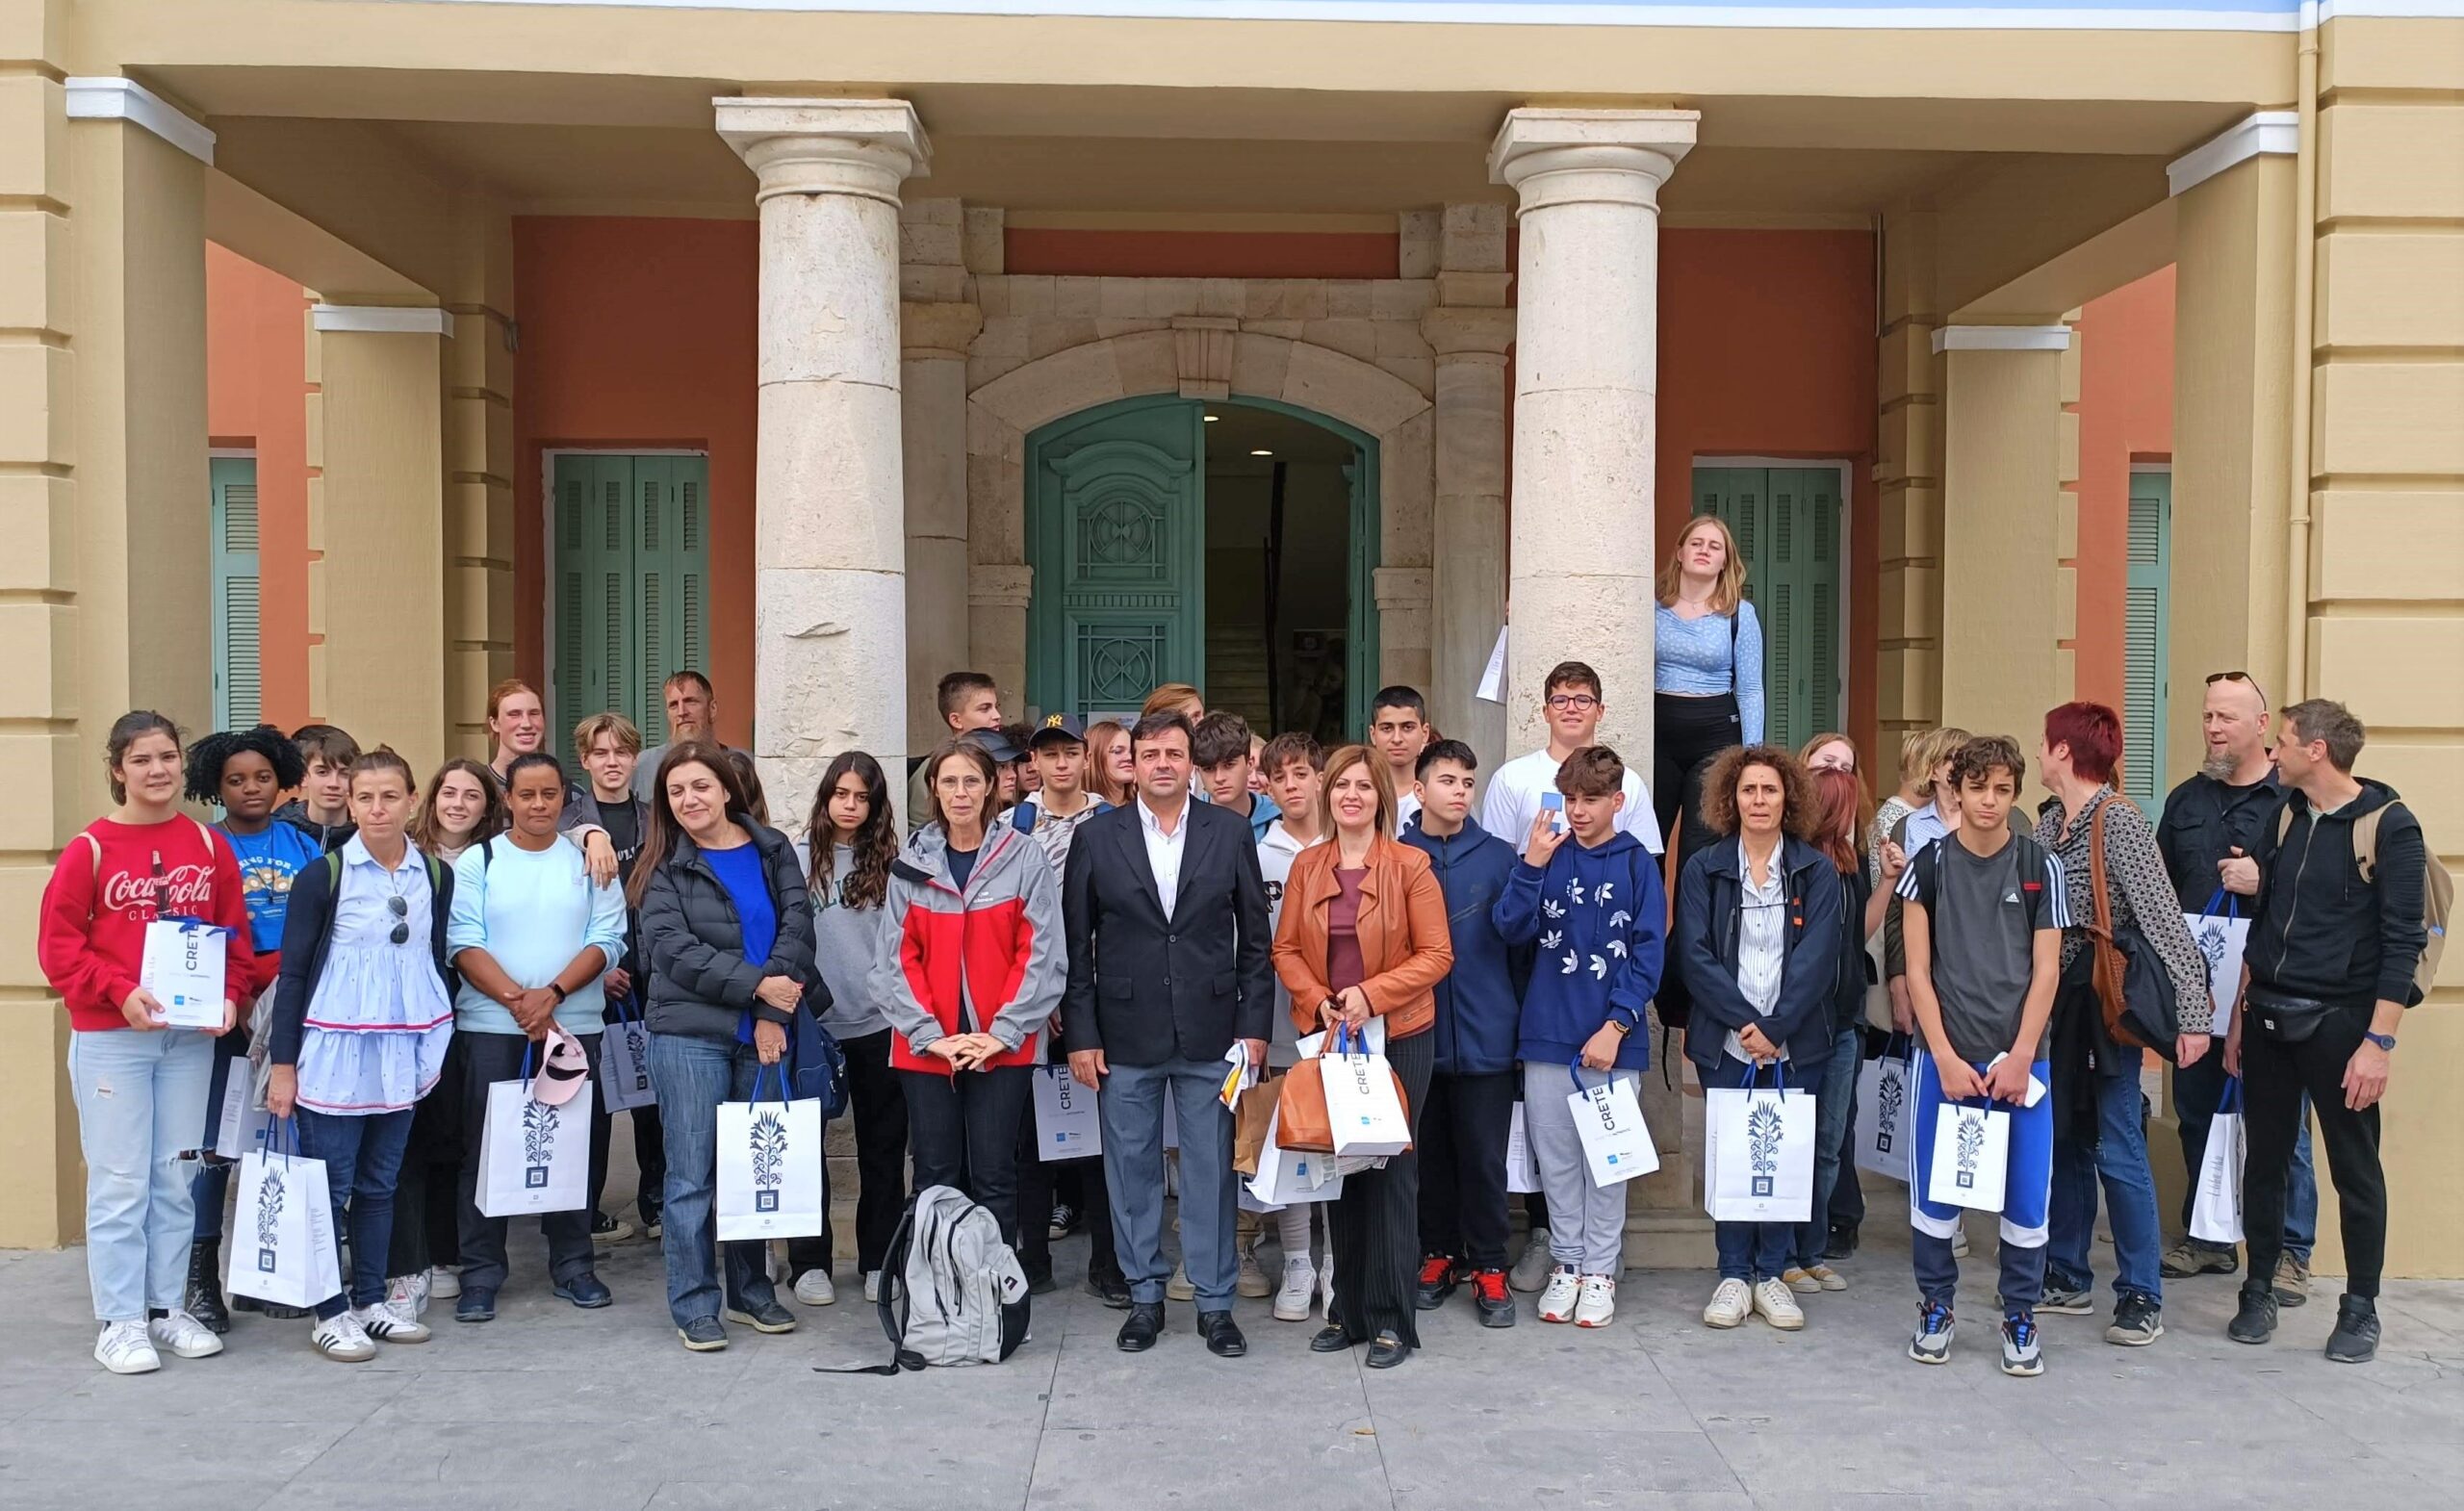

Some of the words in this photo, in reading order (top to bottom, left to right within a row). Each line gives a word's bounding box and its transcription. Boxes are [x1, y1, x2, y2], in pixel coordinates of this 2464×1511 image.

[1046, 714, 1063, 728] NY
[104, 864, 217, 911] CocaCola
[128, 905, 198, 921] CLASIC
[1058, 1065, 1072, 1110] CRETE
[1350, 1053, 1371, 1095] CRETE
[1592, 1087, 1616, 1131] CRETE
